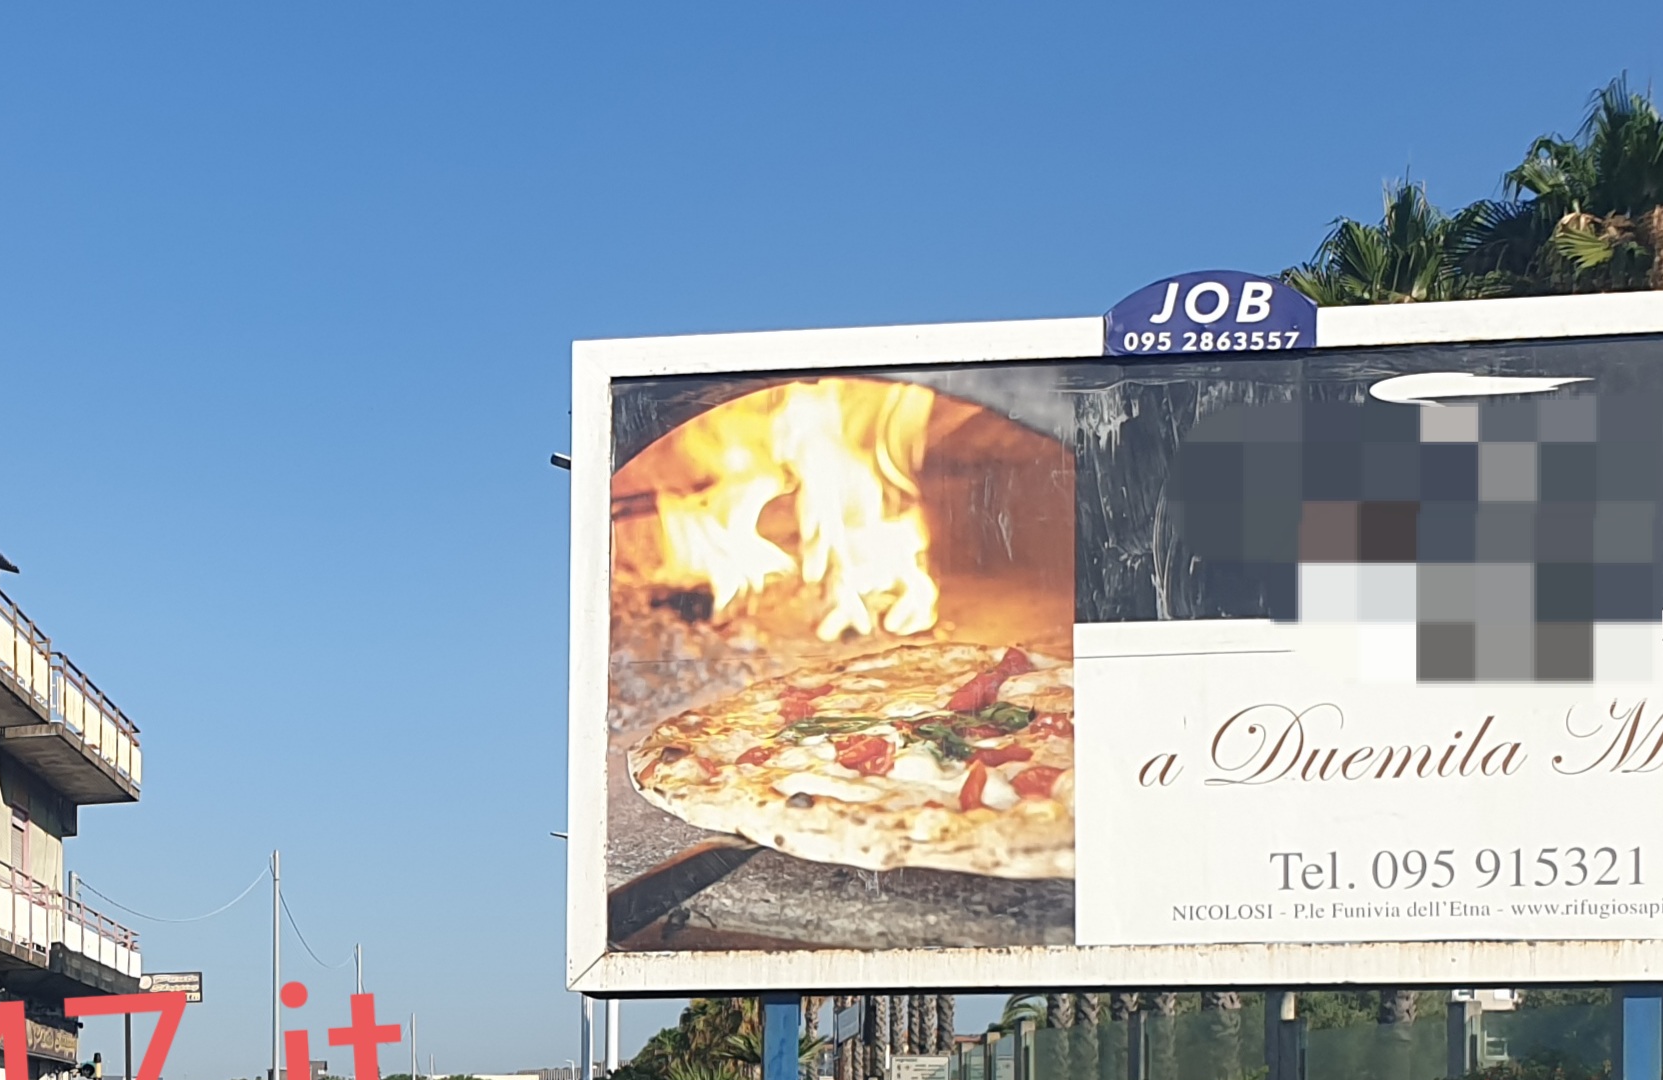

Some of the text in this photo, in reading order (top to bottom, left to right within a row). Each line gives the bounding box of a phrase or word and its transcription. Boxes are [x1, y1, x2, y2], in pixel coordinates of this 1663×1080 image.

[1149, 281, 1274, 324] JOB
[1123, 331, 1300, 351] 095 2863557
[1138, 752, 1185, 788] a
[1204, 702, 1530, 787] Duemila
[1269, 845, 1646, 891] Tel. 095 915321
[1171, 903, 1274, 922] NICOLOSI
[1293, 901, 1325, 920] P.le
[1330, 900, 1401, 919] Funivia
